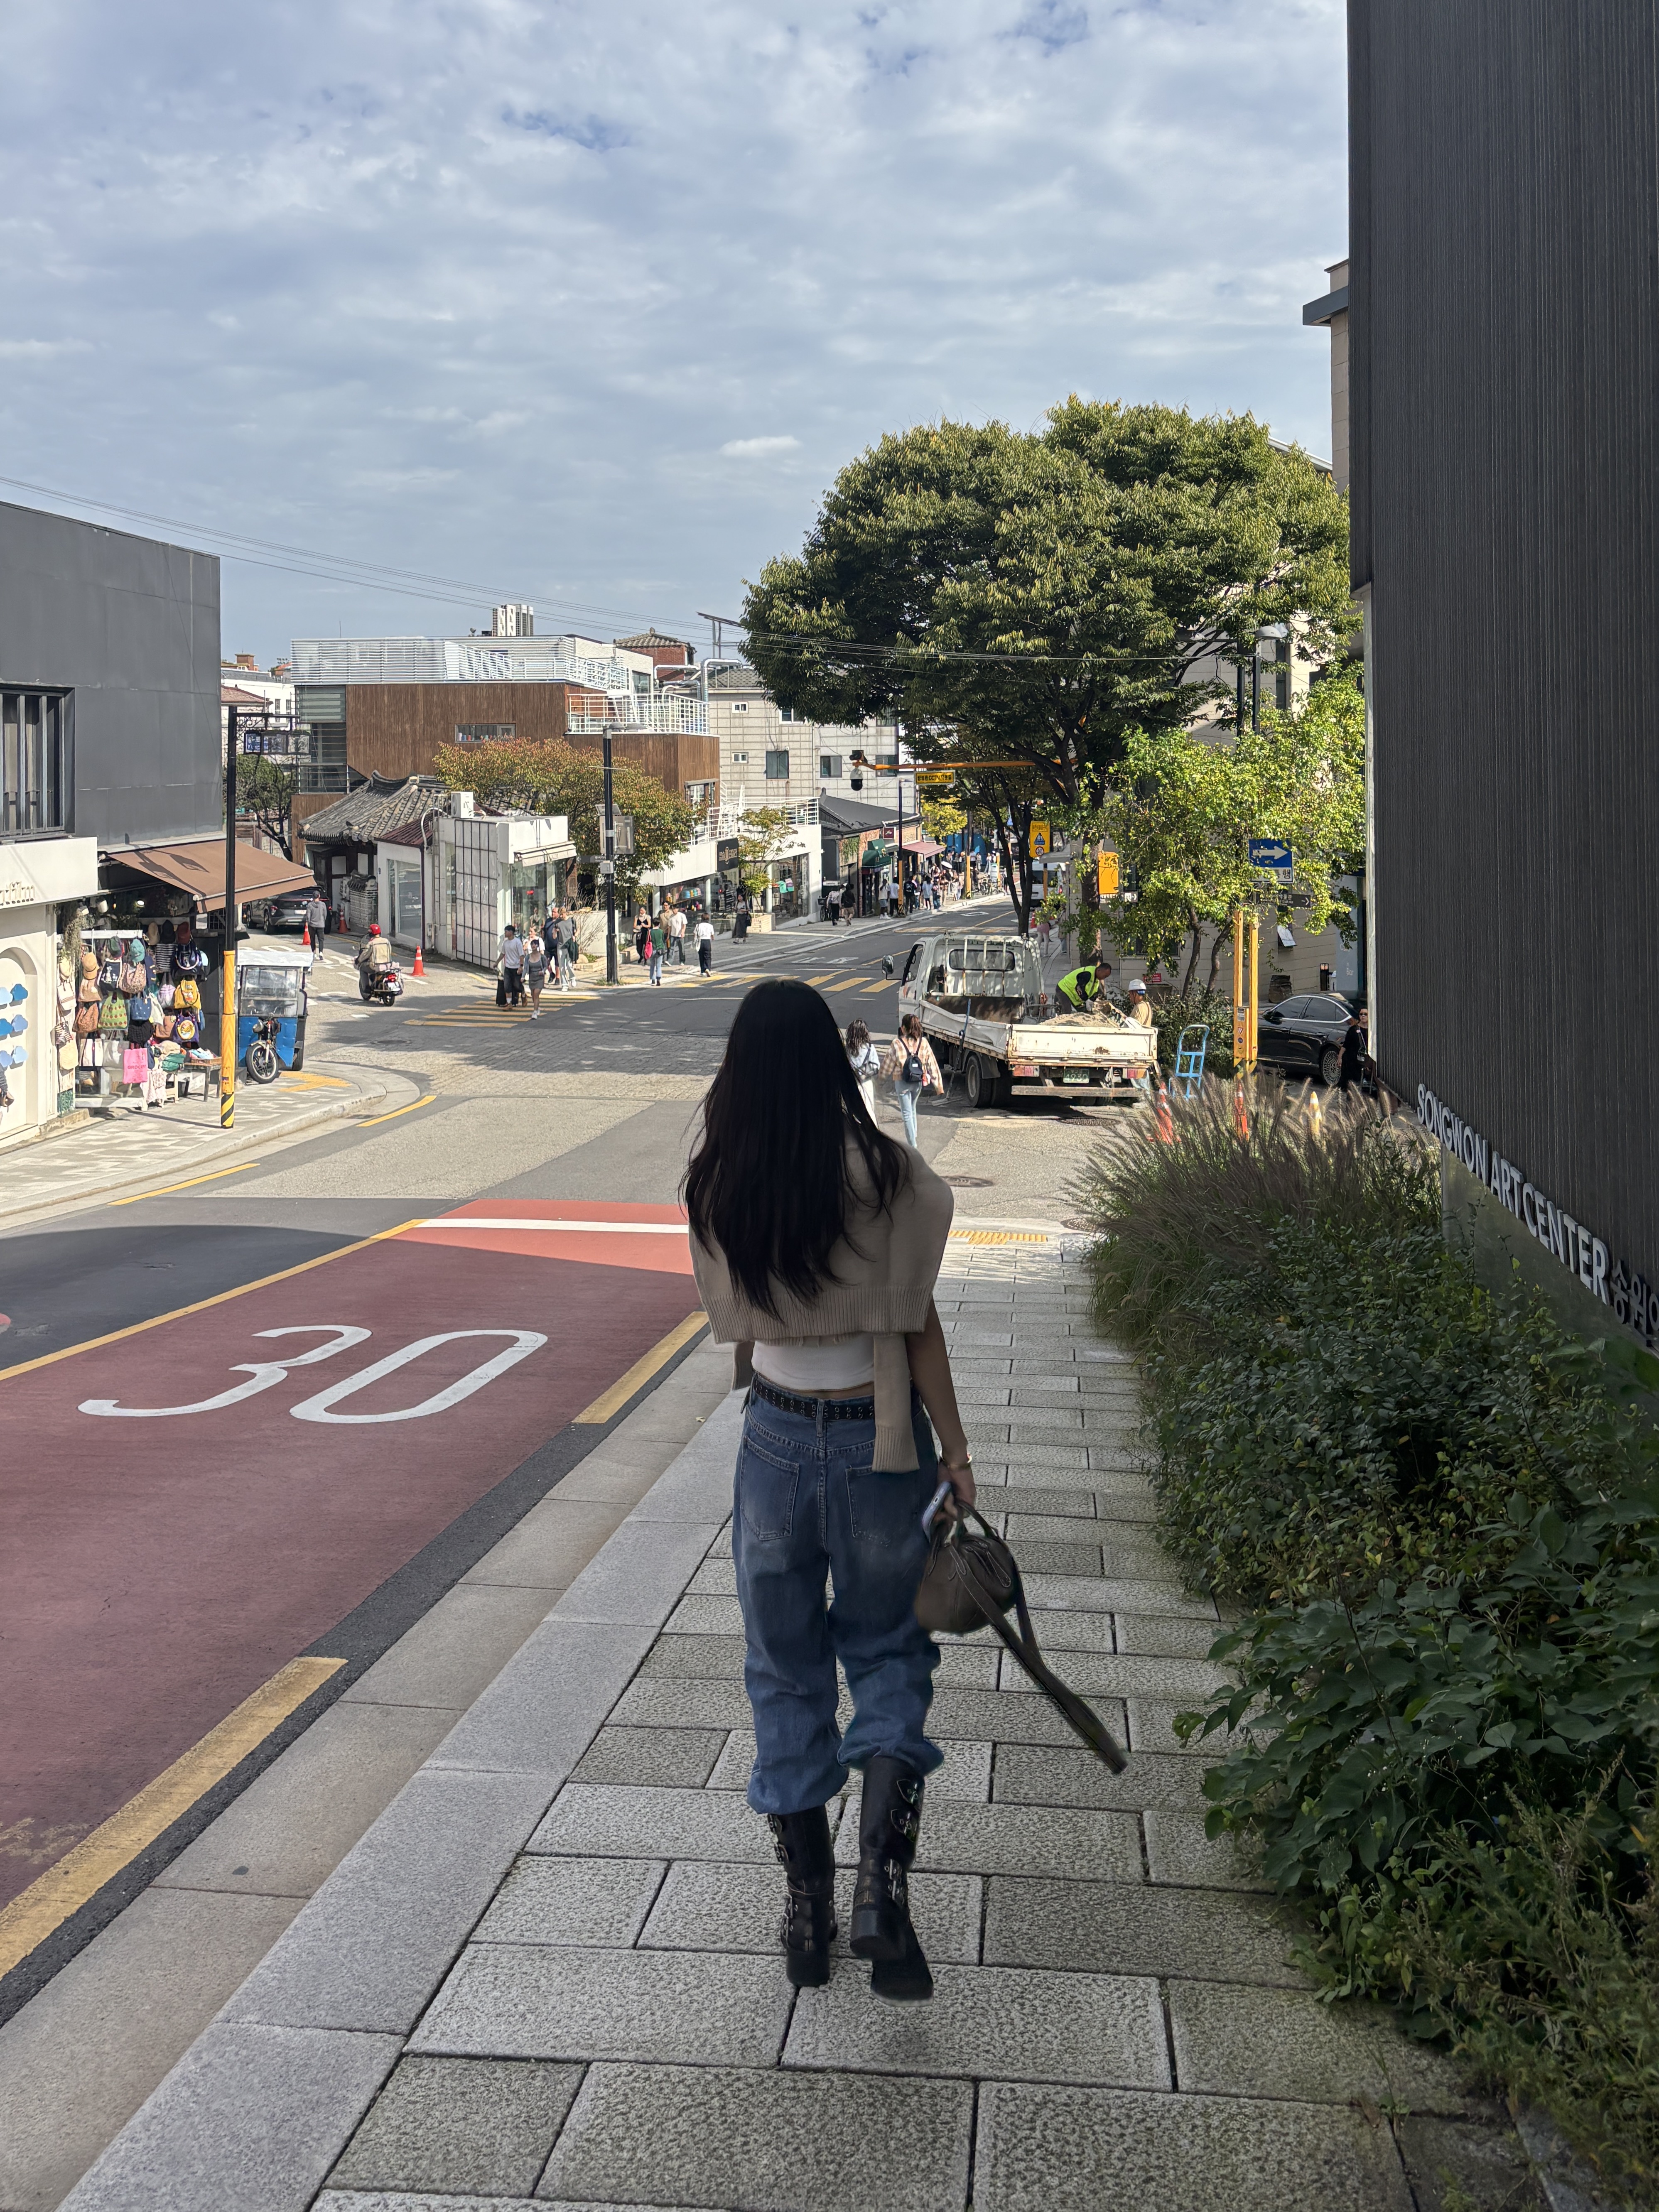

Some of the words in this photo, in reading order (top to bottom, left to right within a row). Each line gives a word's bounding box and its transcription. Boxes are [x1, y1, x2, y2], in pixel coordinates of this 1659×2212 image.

[1417, 1083, 1488, 1185] SONGWON
[1491, 1151, 1524, 1220] ART
[1522, 1182, 1610, 1305] CENTER
[78, 1325, 548, 1423] 30
